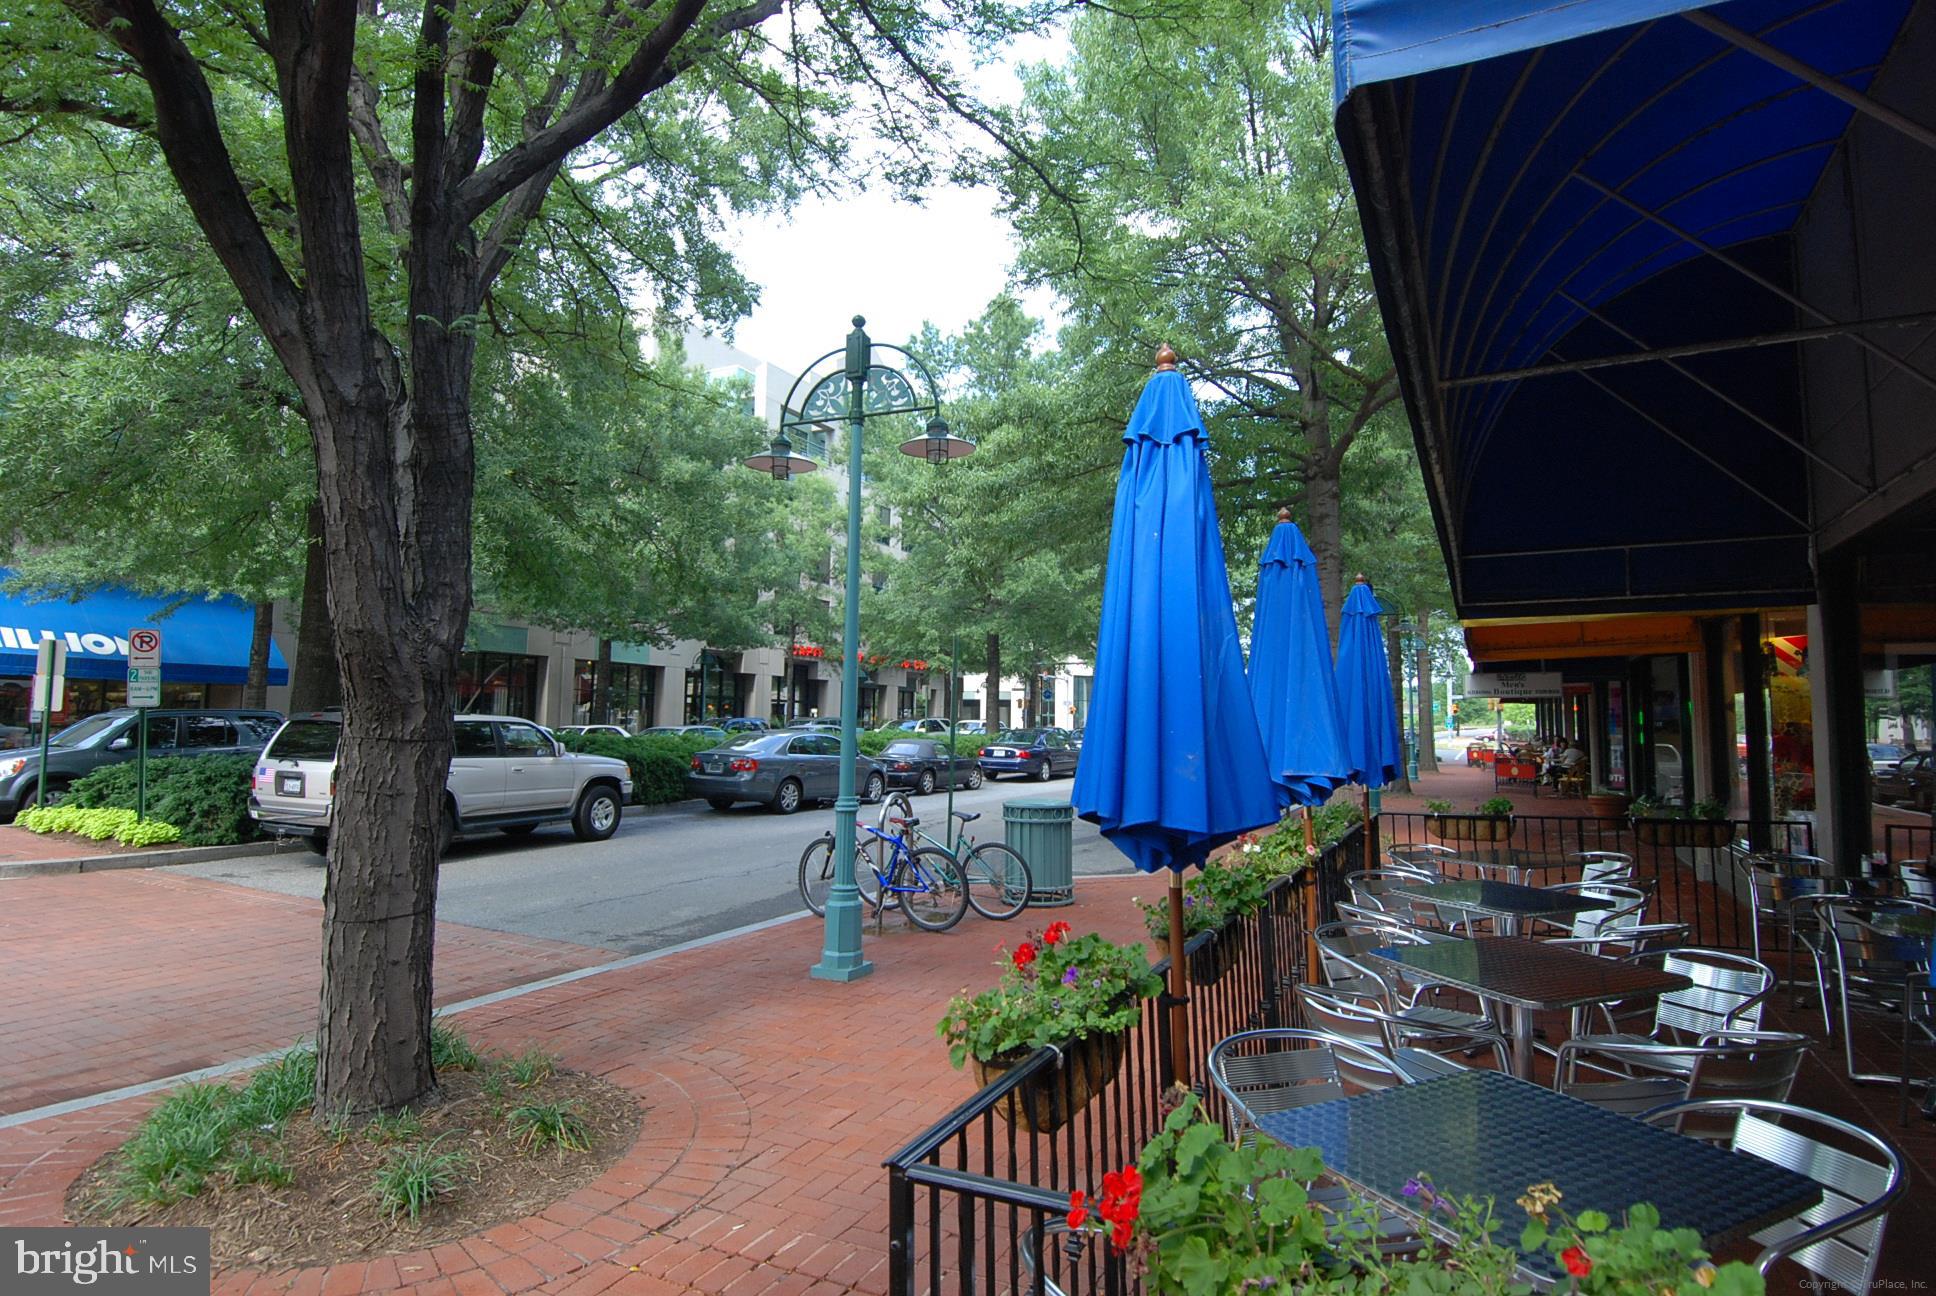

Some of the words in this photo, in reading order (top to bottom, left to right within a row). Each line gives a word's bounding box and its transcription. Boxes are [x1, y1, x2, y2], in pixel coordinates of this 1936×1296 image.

[0, 626, 129, 656] ILIO
[129, 669, 138, 681] 2
[1493, 688, 1532, 696] Boutique
